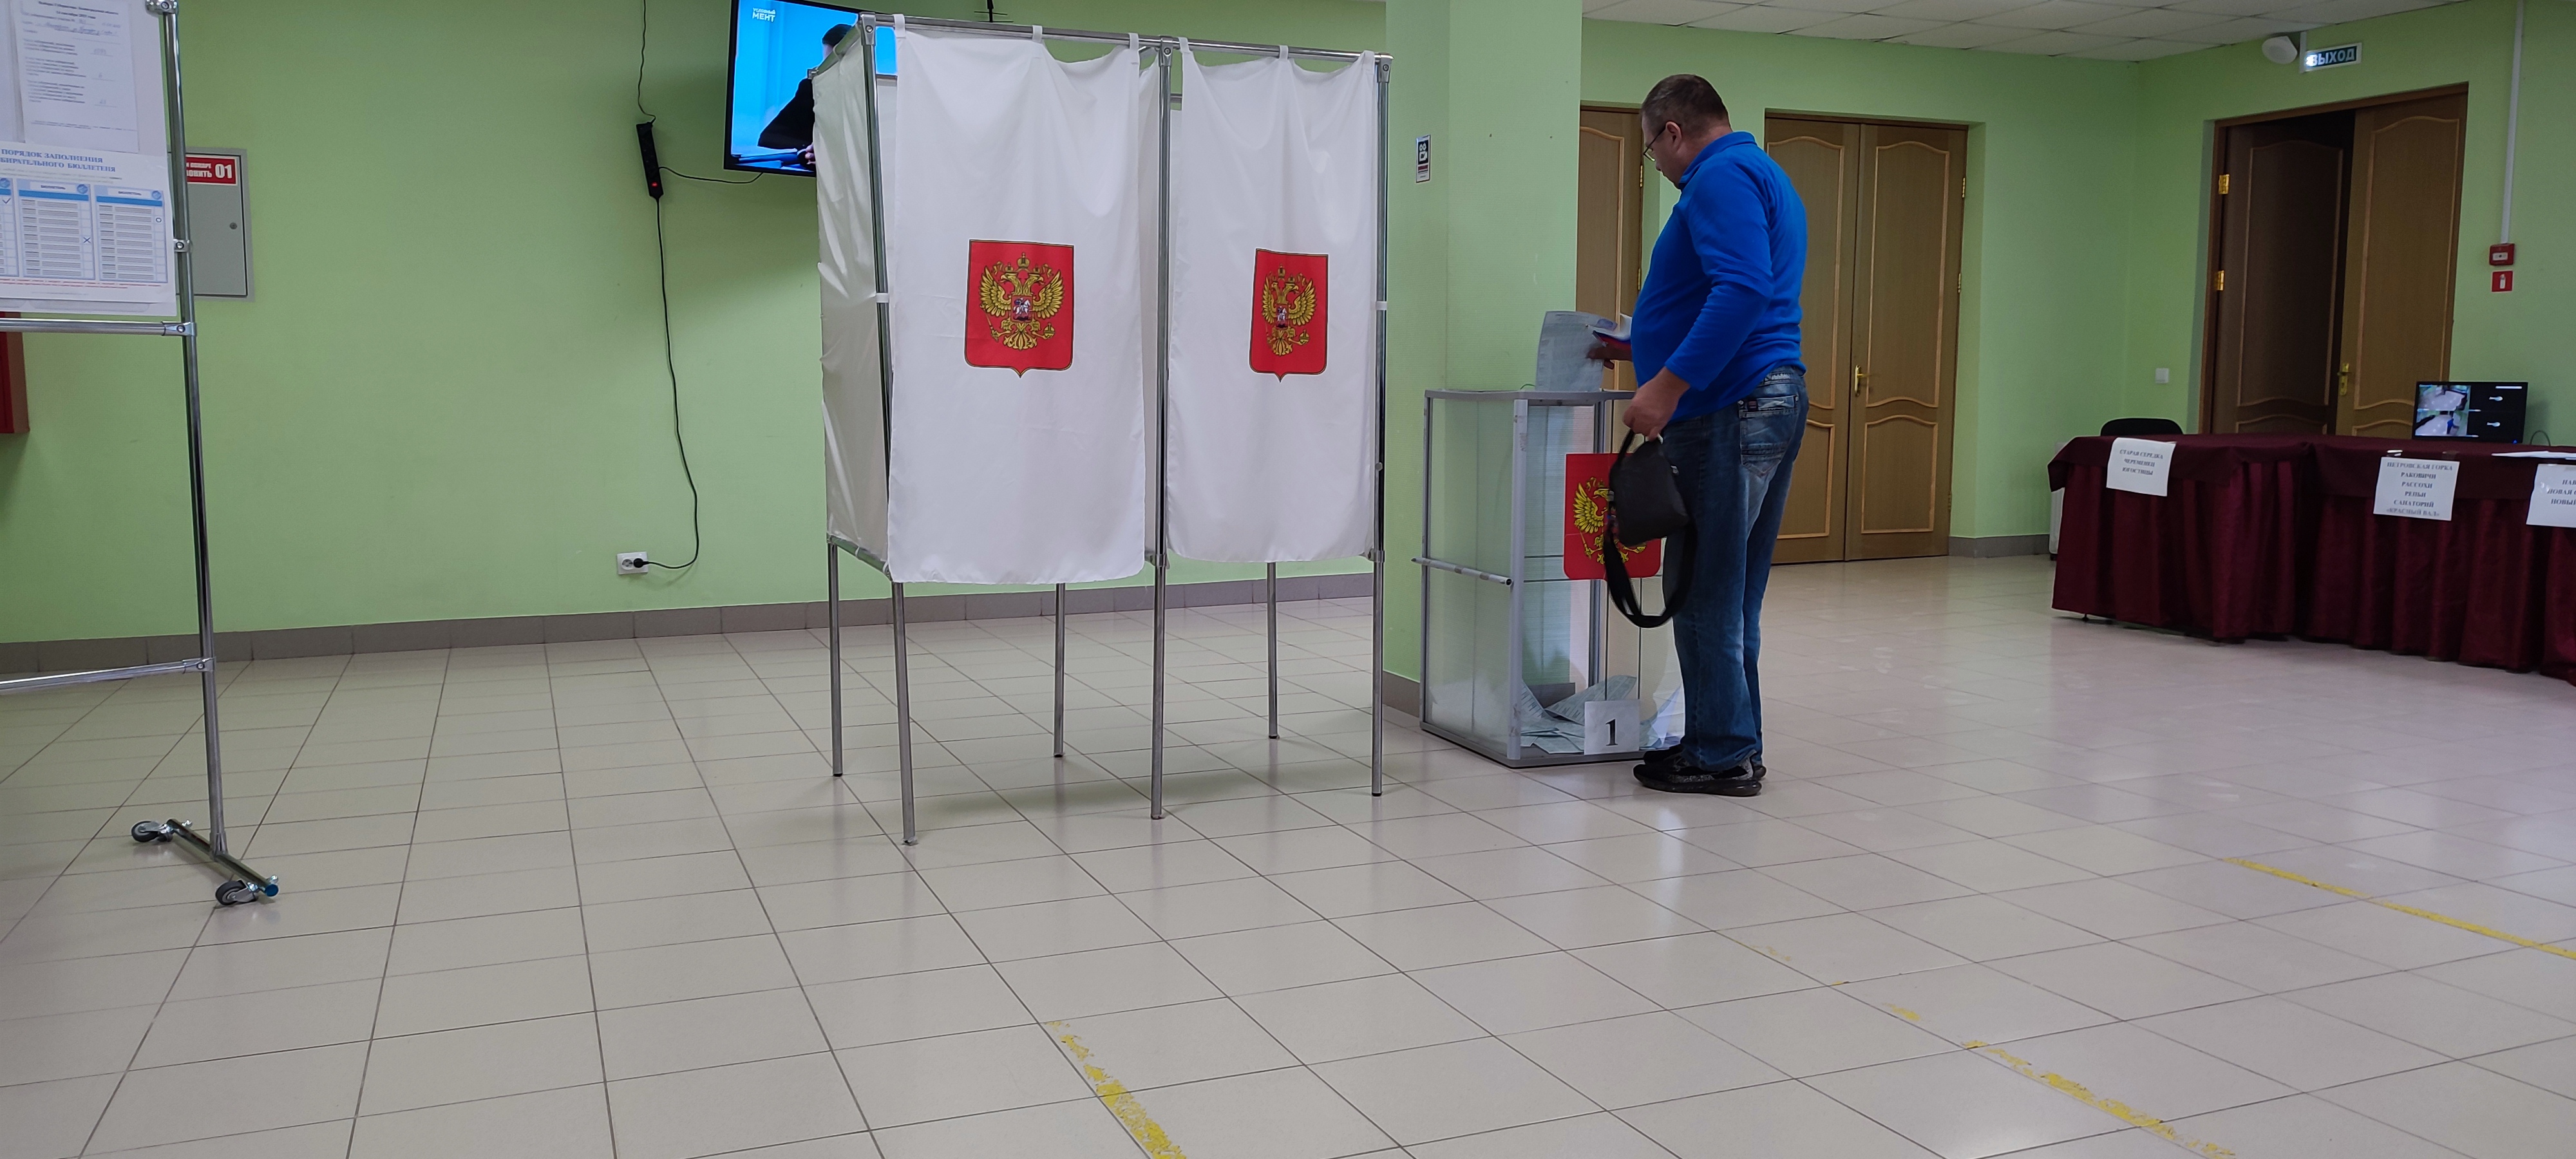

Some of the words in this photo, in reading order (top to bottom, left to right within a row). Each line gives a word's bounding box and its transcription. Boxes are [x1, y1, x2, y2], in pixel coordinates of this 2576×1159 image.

[752, 12, 775, 22] МЕНТ
[2308, 48, 2354, 66] ВЫХОД
[1, 149, 43, 158] ПОРЯДОК
[44, 153, 103, 163] ЗАПОЛНЕНИЯ
[68, 163, 116, 172] БЮЛЛЕТЕНЯ
[214, 164, 232, 178] 01
[1605, 719, 1618, 746] 1
